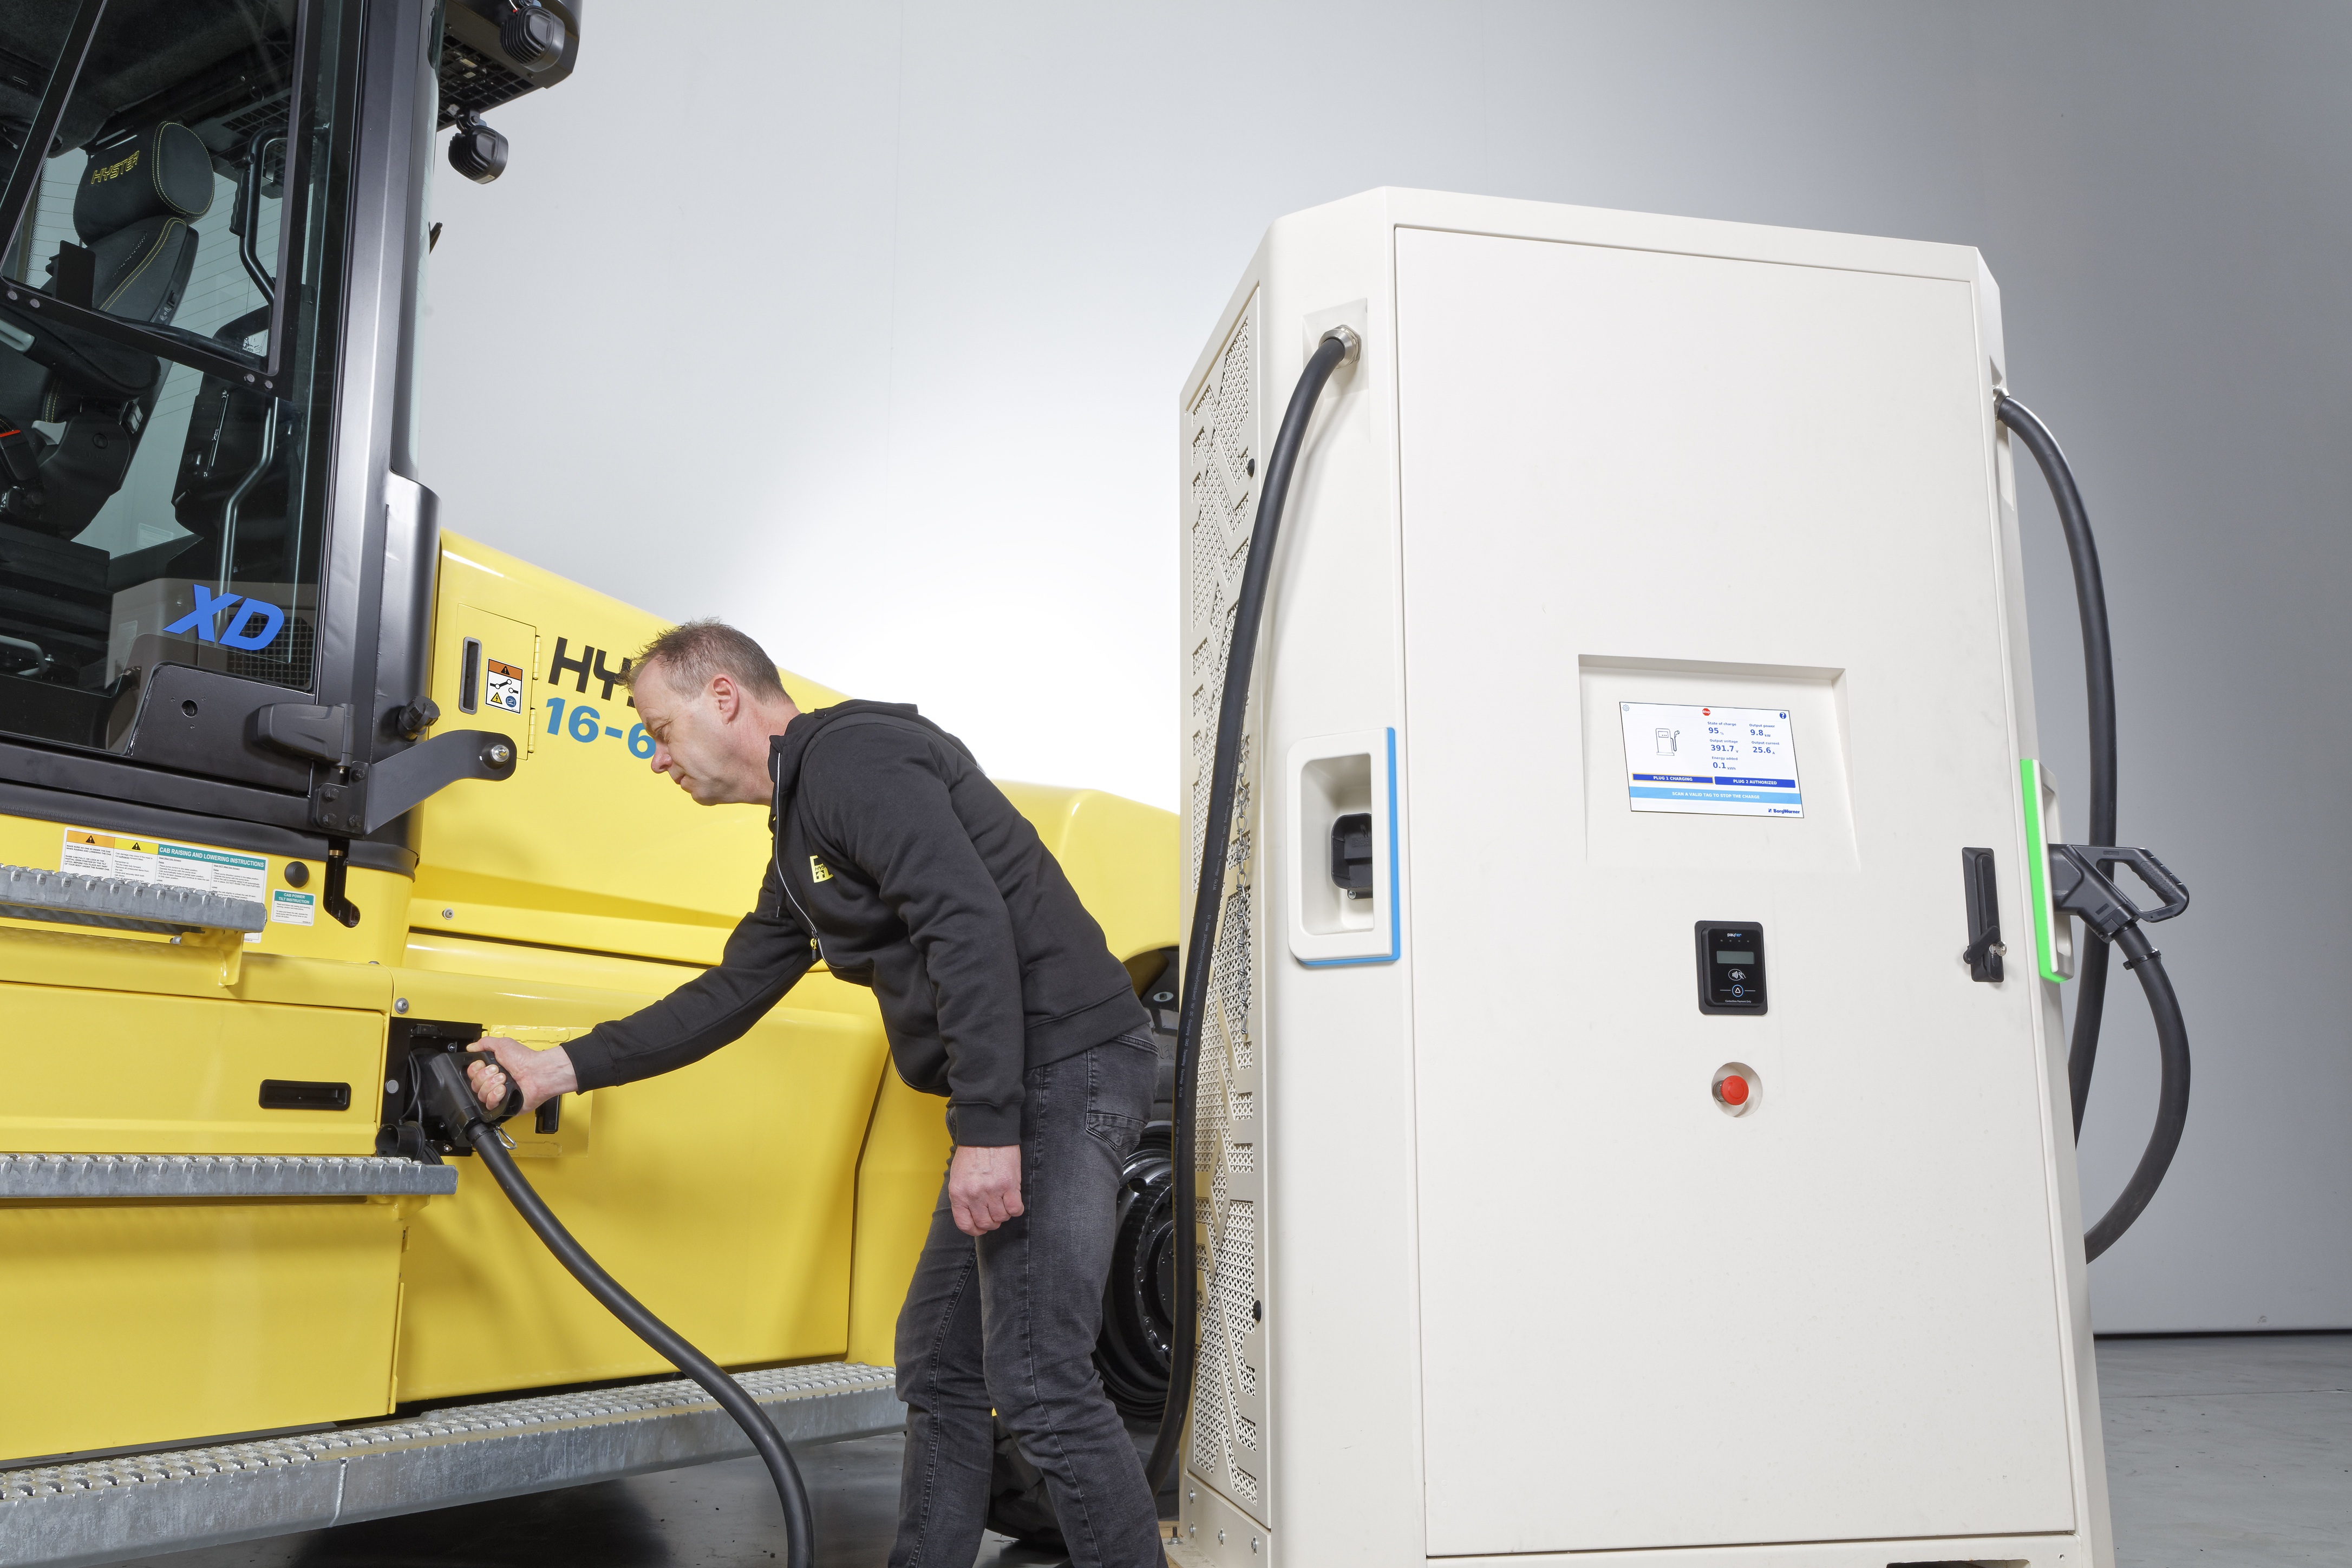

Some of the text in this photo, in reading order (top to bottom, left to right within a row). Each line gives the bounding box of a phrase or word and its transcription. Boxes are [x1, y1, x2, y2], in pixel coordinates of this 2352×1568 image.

[91, 151, 139, 184] HYSTER
[162, 584, 284, 650] XD
[548, 636, 636, 708] HY
[171, 848, 191, 857] RAISING
[203, 853, 229, 863] LOWERING
[230, 857, 264, 867] INSTRUCTIONS
